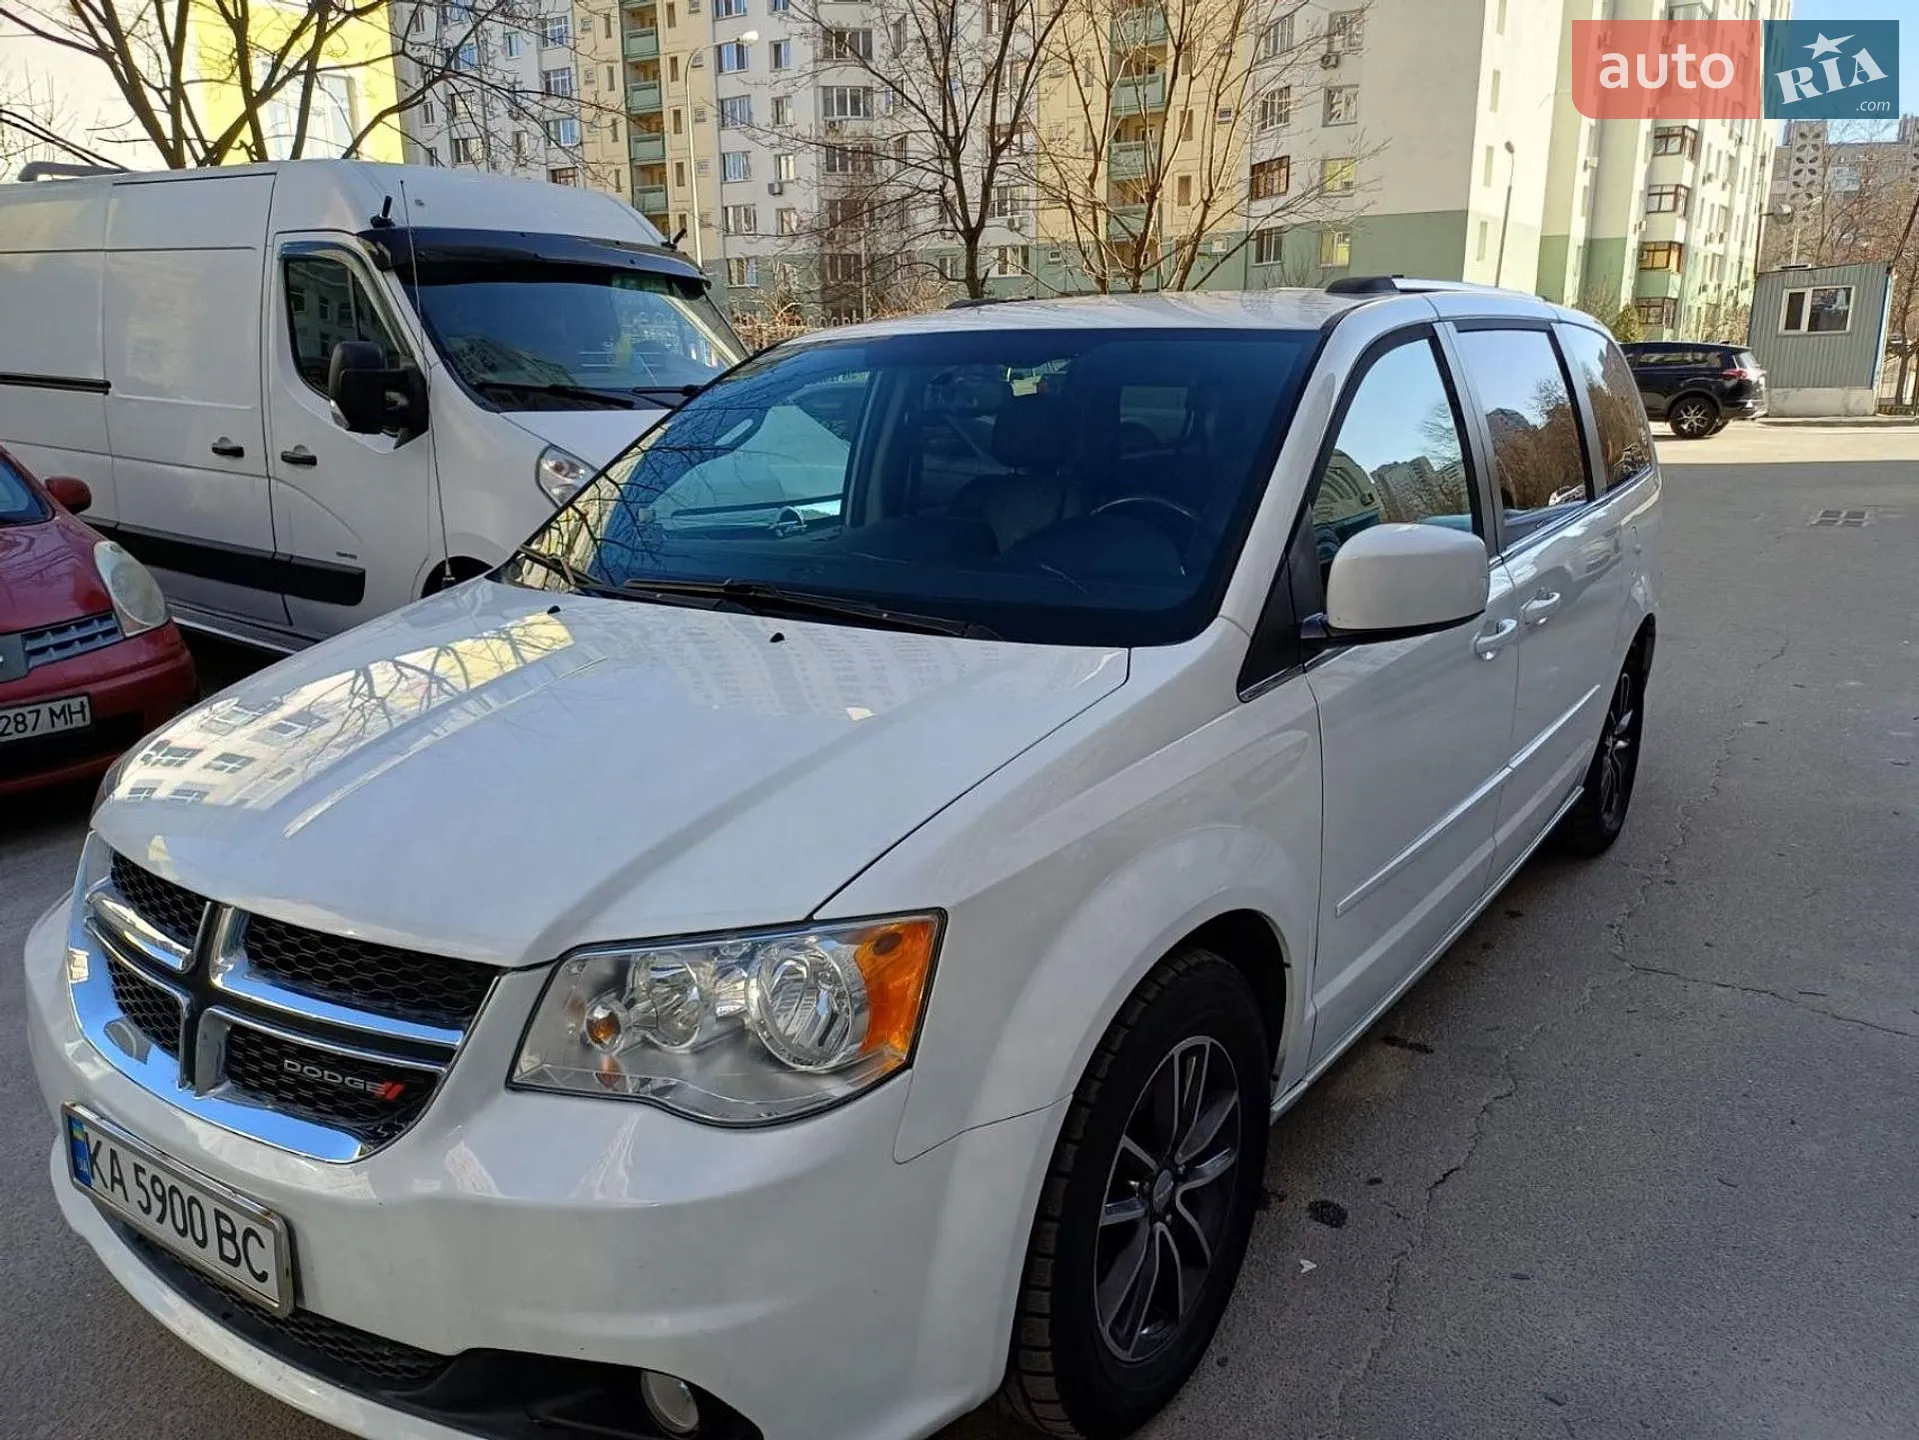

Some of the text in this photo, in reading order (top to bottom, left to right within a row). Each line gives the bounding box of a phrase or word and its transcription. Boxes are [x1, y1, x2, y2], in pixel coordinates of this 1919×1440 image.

[0, 701, 87, 737] 287 MH
[283, 1059, 386, 1096] DODGE
[84, 1132, 269, 1284] KA 5900 BC
